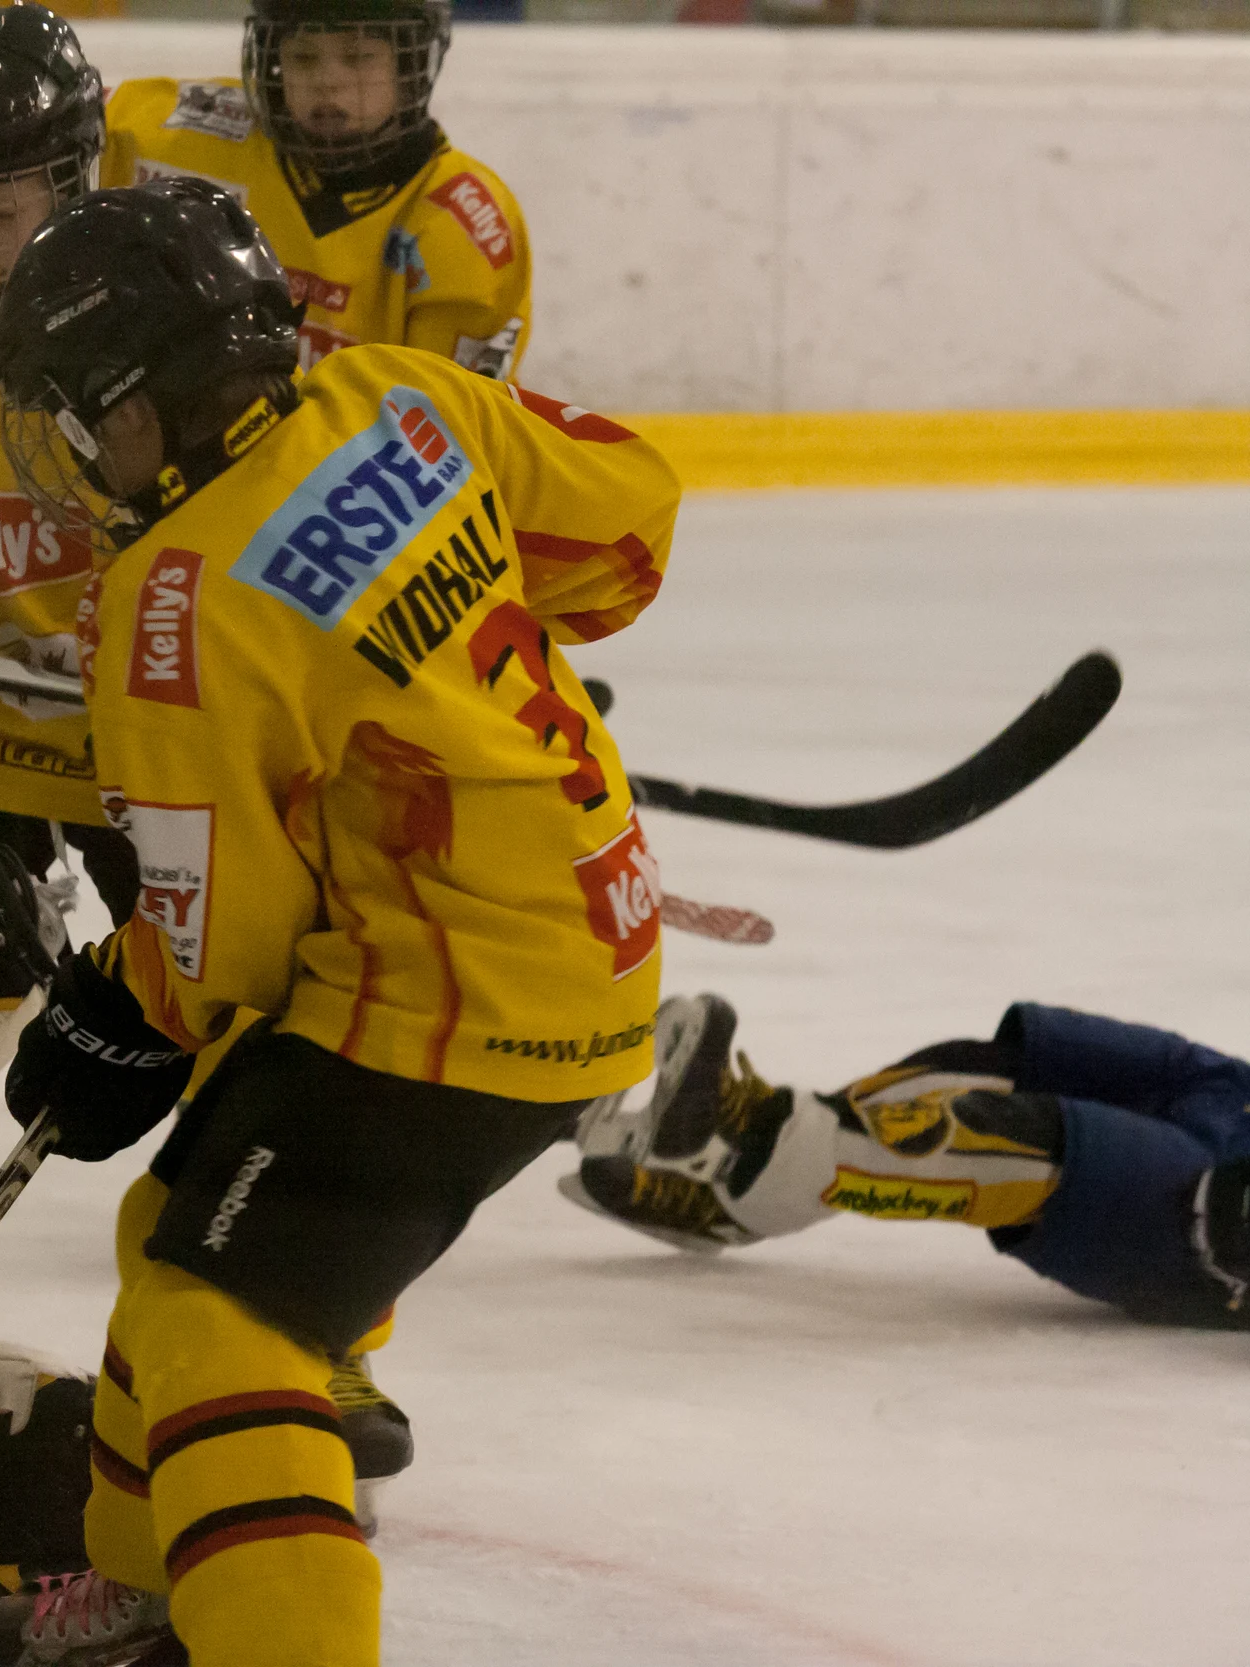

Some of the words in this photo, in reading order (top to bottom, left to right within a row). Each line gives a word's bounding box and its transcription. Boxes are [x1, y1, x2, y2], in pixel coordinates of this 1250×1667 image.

[261, 440, 445, 612] ERSTE
[141, 566, 191, 682] Kelly's
[202, 1145, 276, 1252] Reebok
